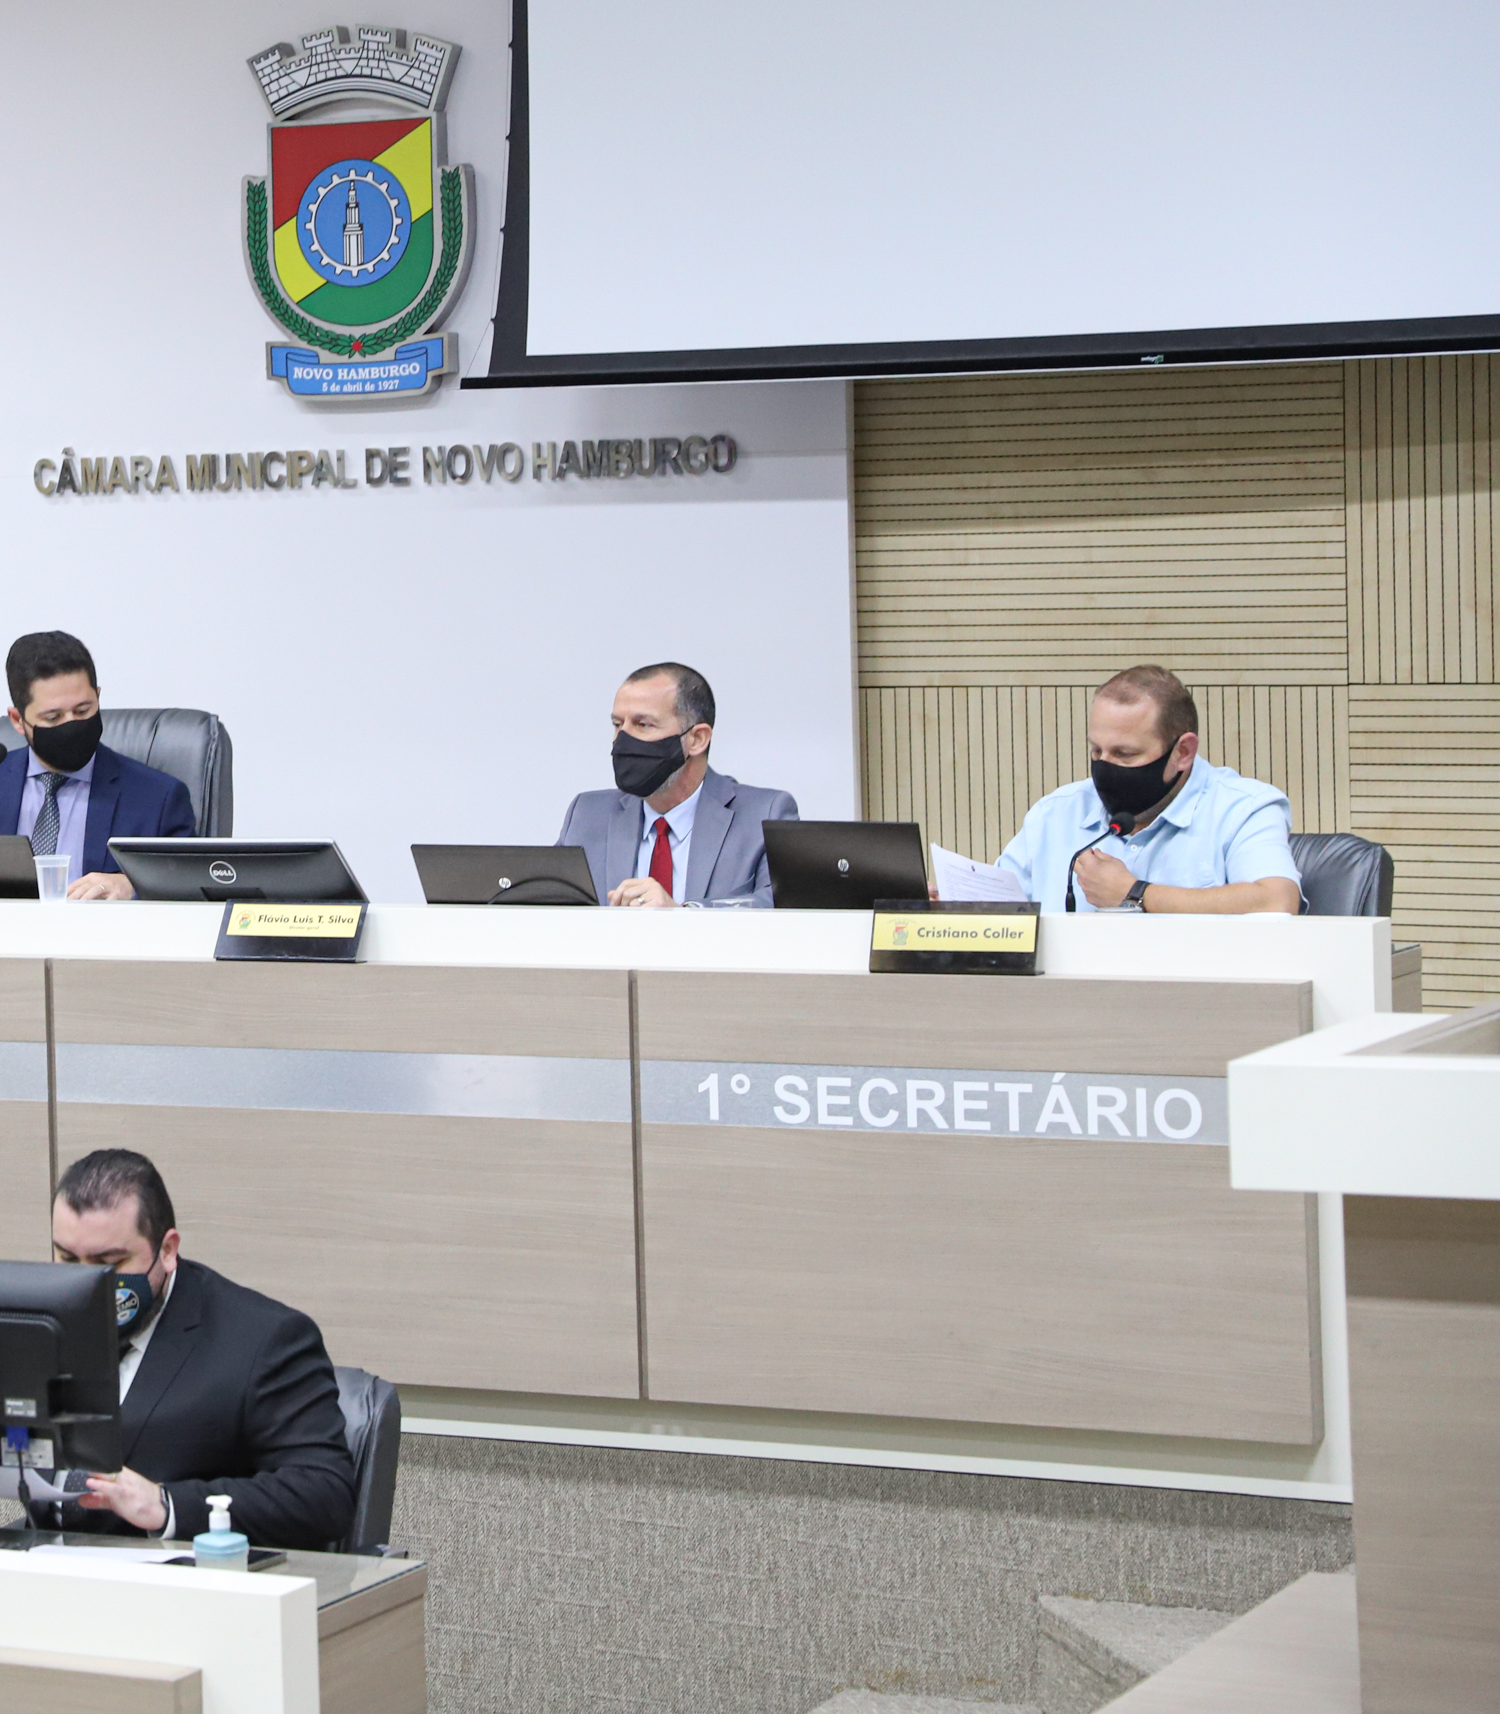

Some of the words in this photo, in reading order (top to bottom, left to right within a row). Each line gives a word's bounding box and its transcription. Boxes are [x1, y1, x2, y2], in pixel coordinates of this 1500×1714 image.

[293, 367, 334, 380] NOVO
[337, 362, 421, 380] HAMBURGO
[322, 382, 329, 392] 5
[330, 381, 341, 392] de
[342, 381, 363, 392] abril
[364, 381, 376, 391] de
[378, 379, 400, 390] 1927
[33, 446, 181, 495] CÂMARA
[185, 448, 358, 493] MUNICIPAL
[364, 446, 411, 487] DE
[421, 441, 525, 486] NOVO
[531, 434, 739, 484] HAMBURGO
[258, 914, 290, 924] Flávio
[293, 914, 314, 924] Luis
[317, 915, 325, 924] T.
[328, 915, 355, 925] Silva
[916, 926, 979, 939] Cristiano
[983, 927, 1025, 939] Coller
[772, 1072, 1203, 1140] SECRETÁRIO
